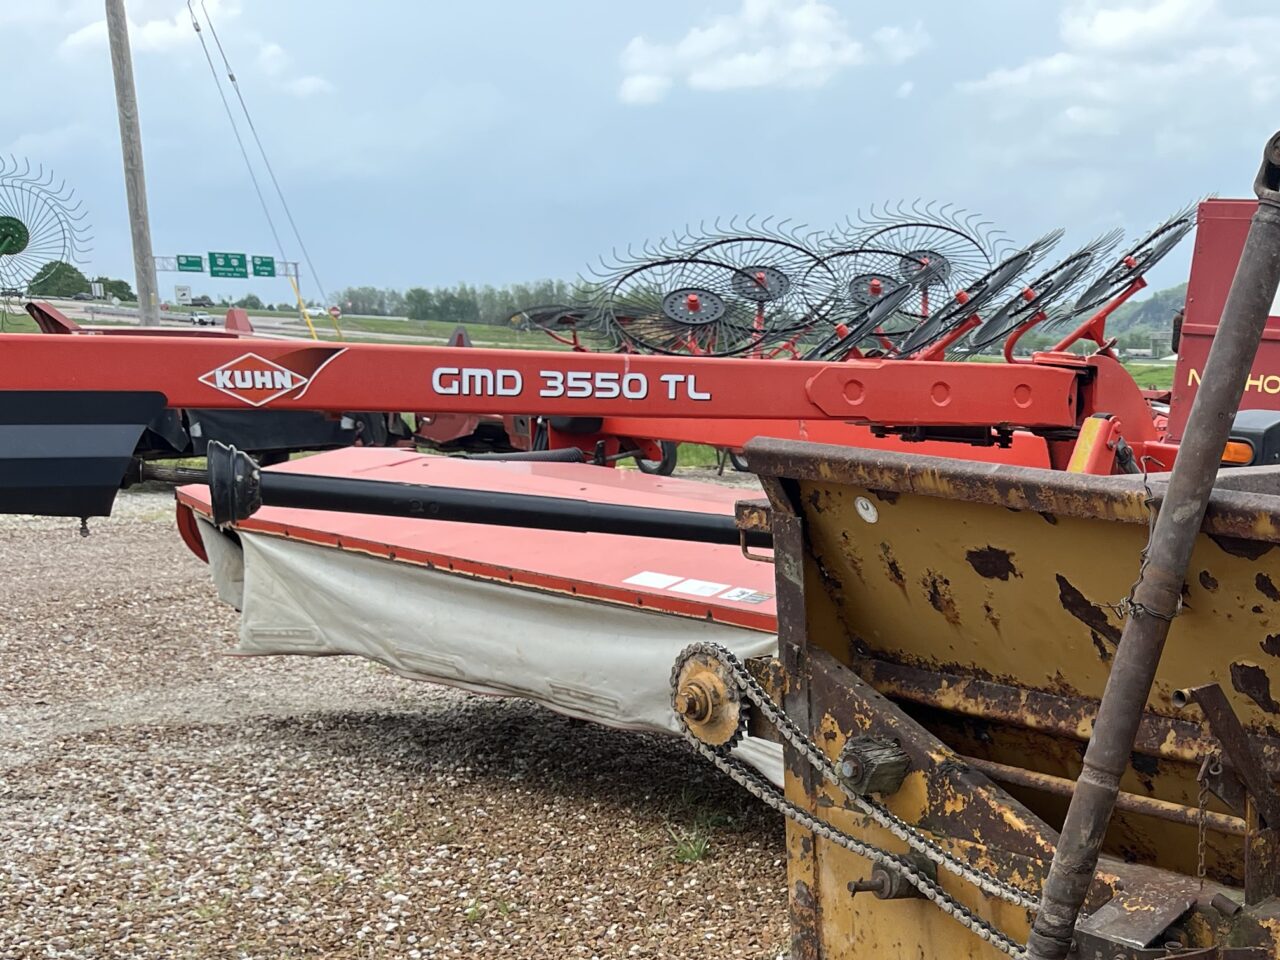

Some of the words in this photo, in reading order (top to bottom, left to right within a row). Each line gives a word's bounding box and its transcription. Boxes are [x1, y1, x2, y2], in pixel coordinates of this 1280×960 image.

[215, 370, 293, 389] KUHN
[431, 367, 523, 396] GMD
[539, 370, 649, 400] 3550
[660, 374, 712, 400] TL
